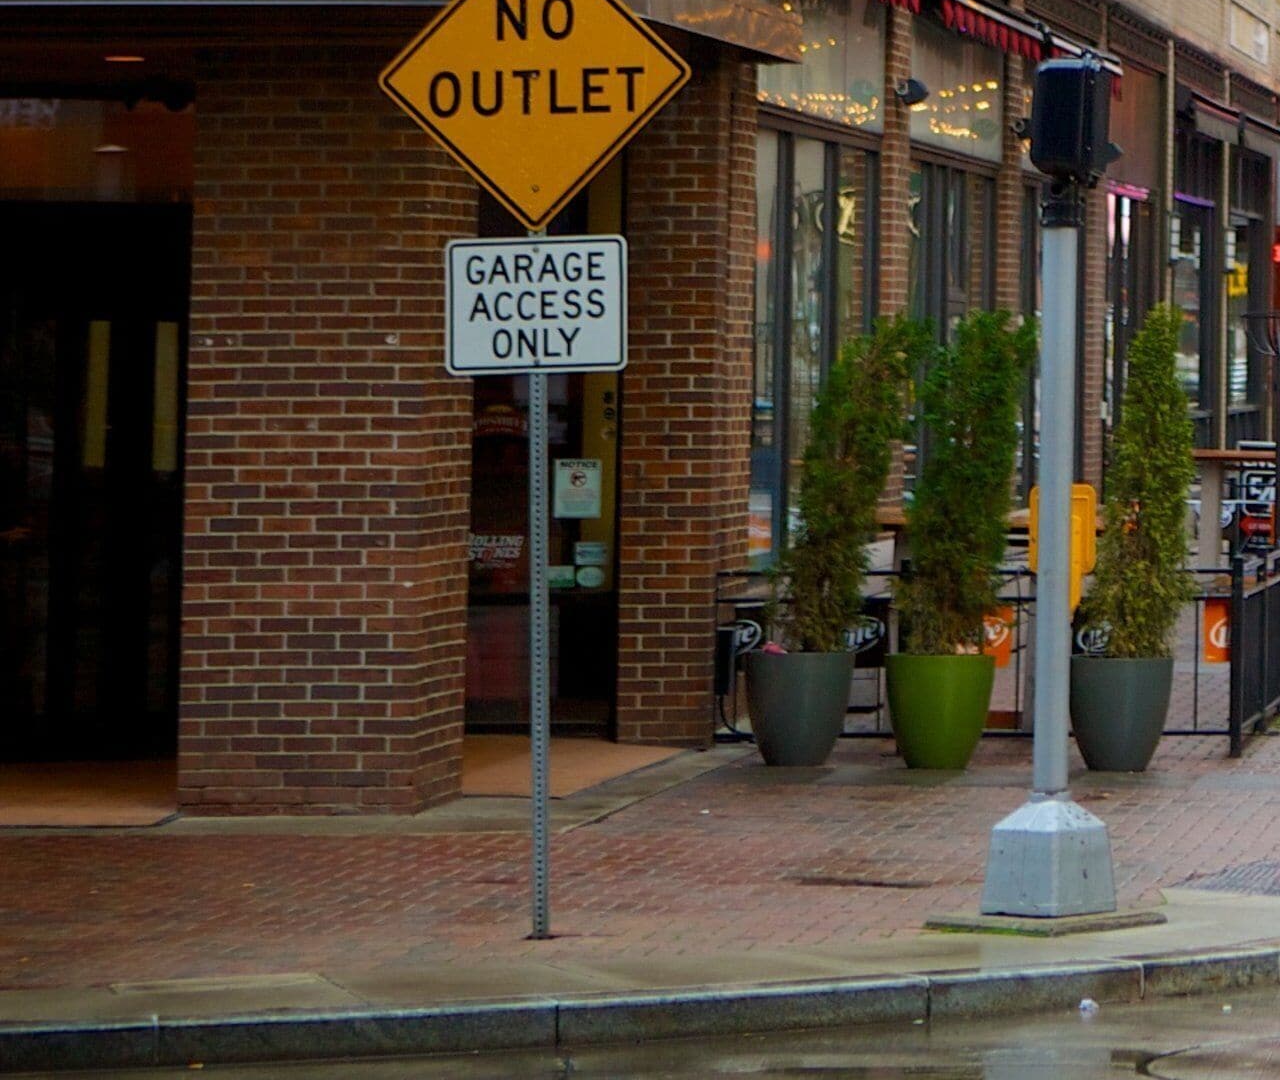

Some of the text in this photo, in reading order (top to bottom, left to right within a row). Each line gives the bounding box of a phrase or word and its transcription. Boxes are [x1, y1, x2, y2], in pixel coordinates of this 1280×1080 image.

[428, 66, 645, 119] OUTLET
[465, 251, 607, 286] GARAGE
[468, 288, 607, 323] ACCESS
[491, 326, 582, 360] ONLY
